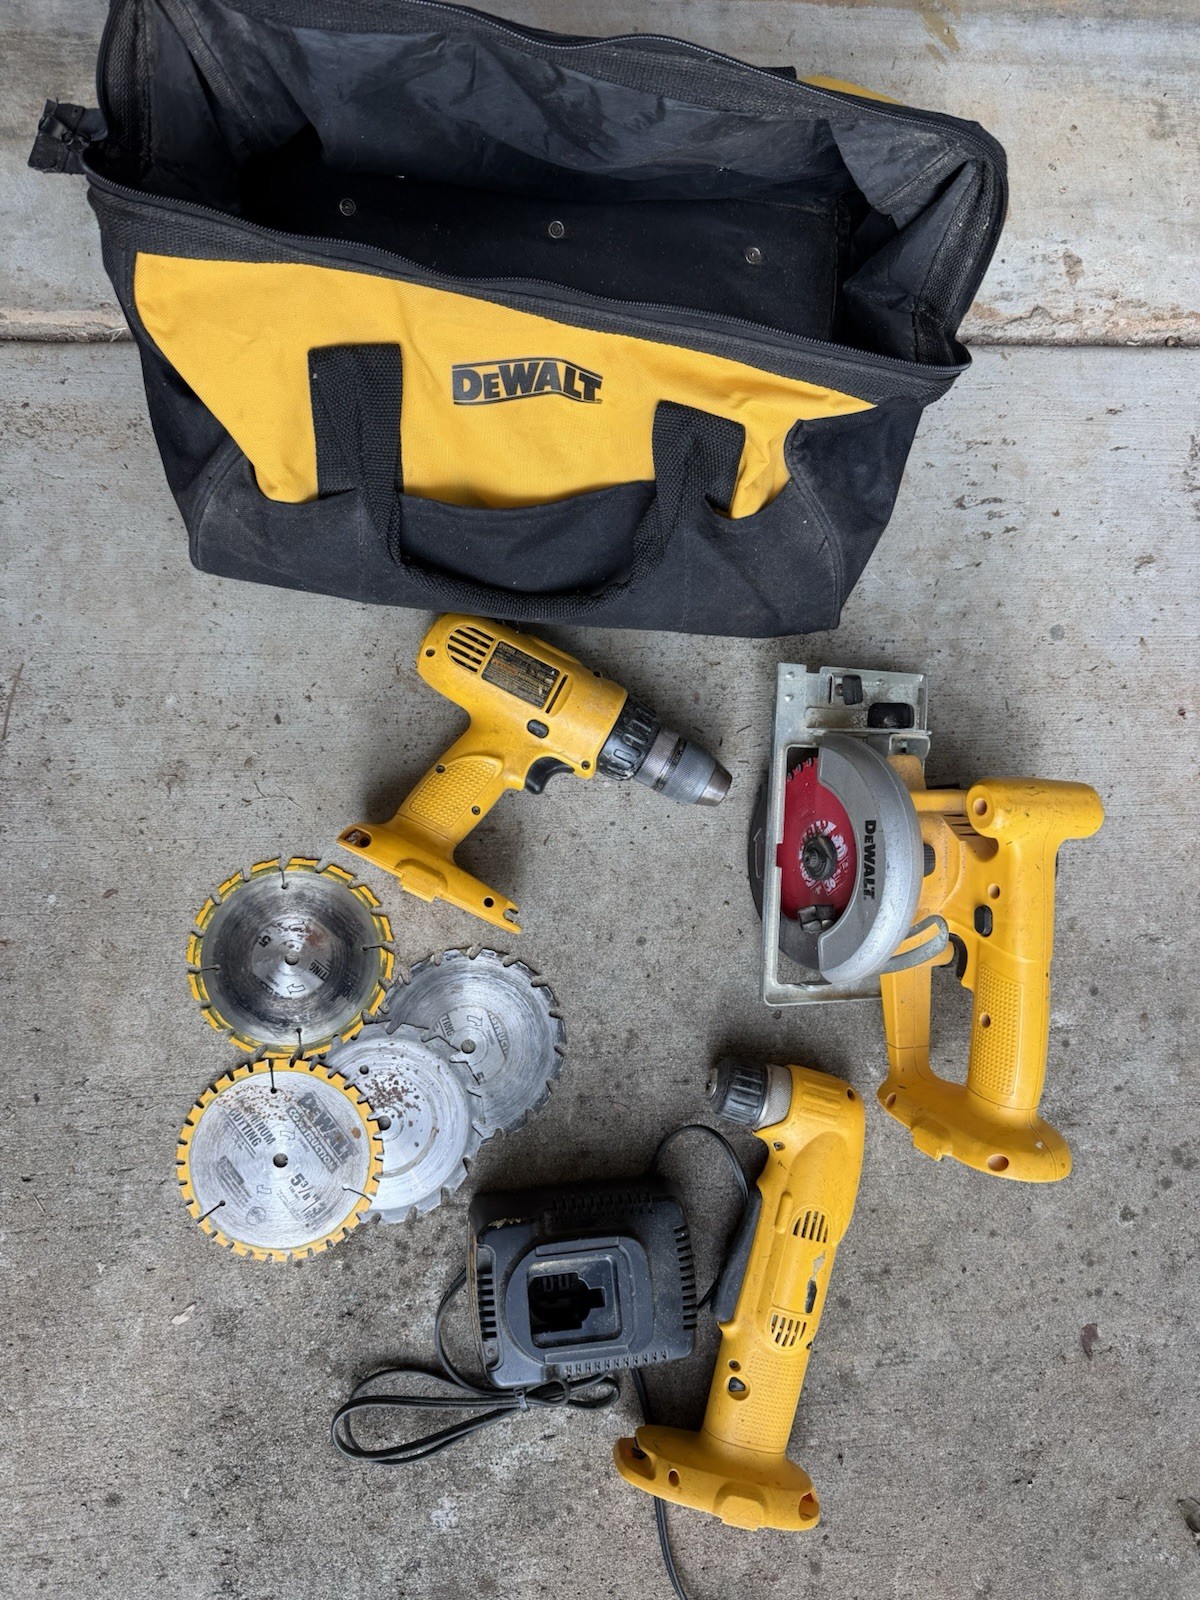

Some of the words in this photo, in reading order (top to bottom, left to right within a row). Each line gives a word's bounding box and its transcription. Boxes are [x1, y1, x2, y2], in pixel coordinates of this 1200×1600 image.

[452, 360, 602, 402] DEWALT
[863, 820, 876, 900] DEWALT
[228, 1107, 262, 1147] CUTTING
